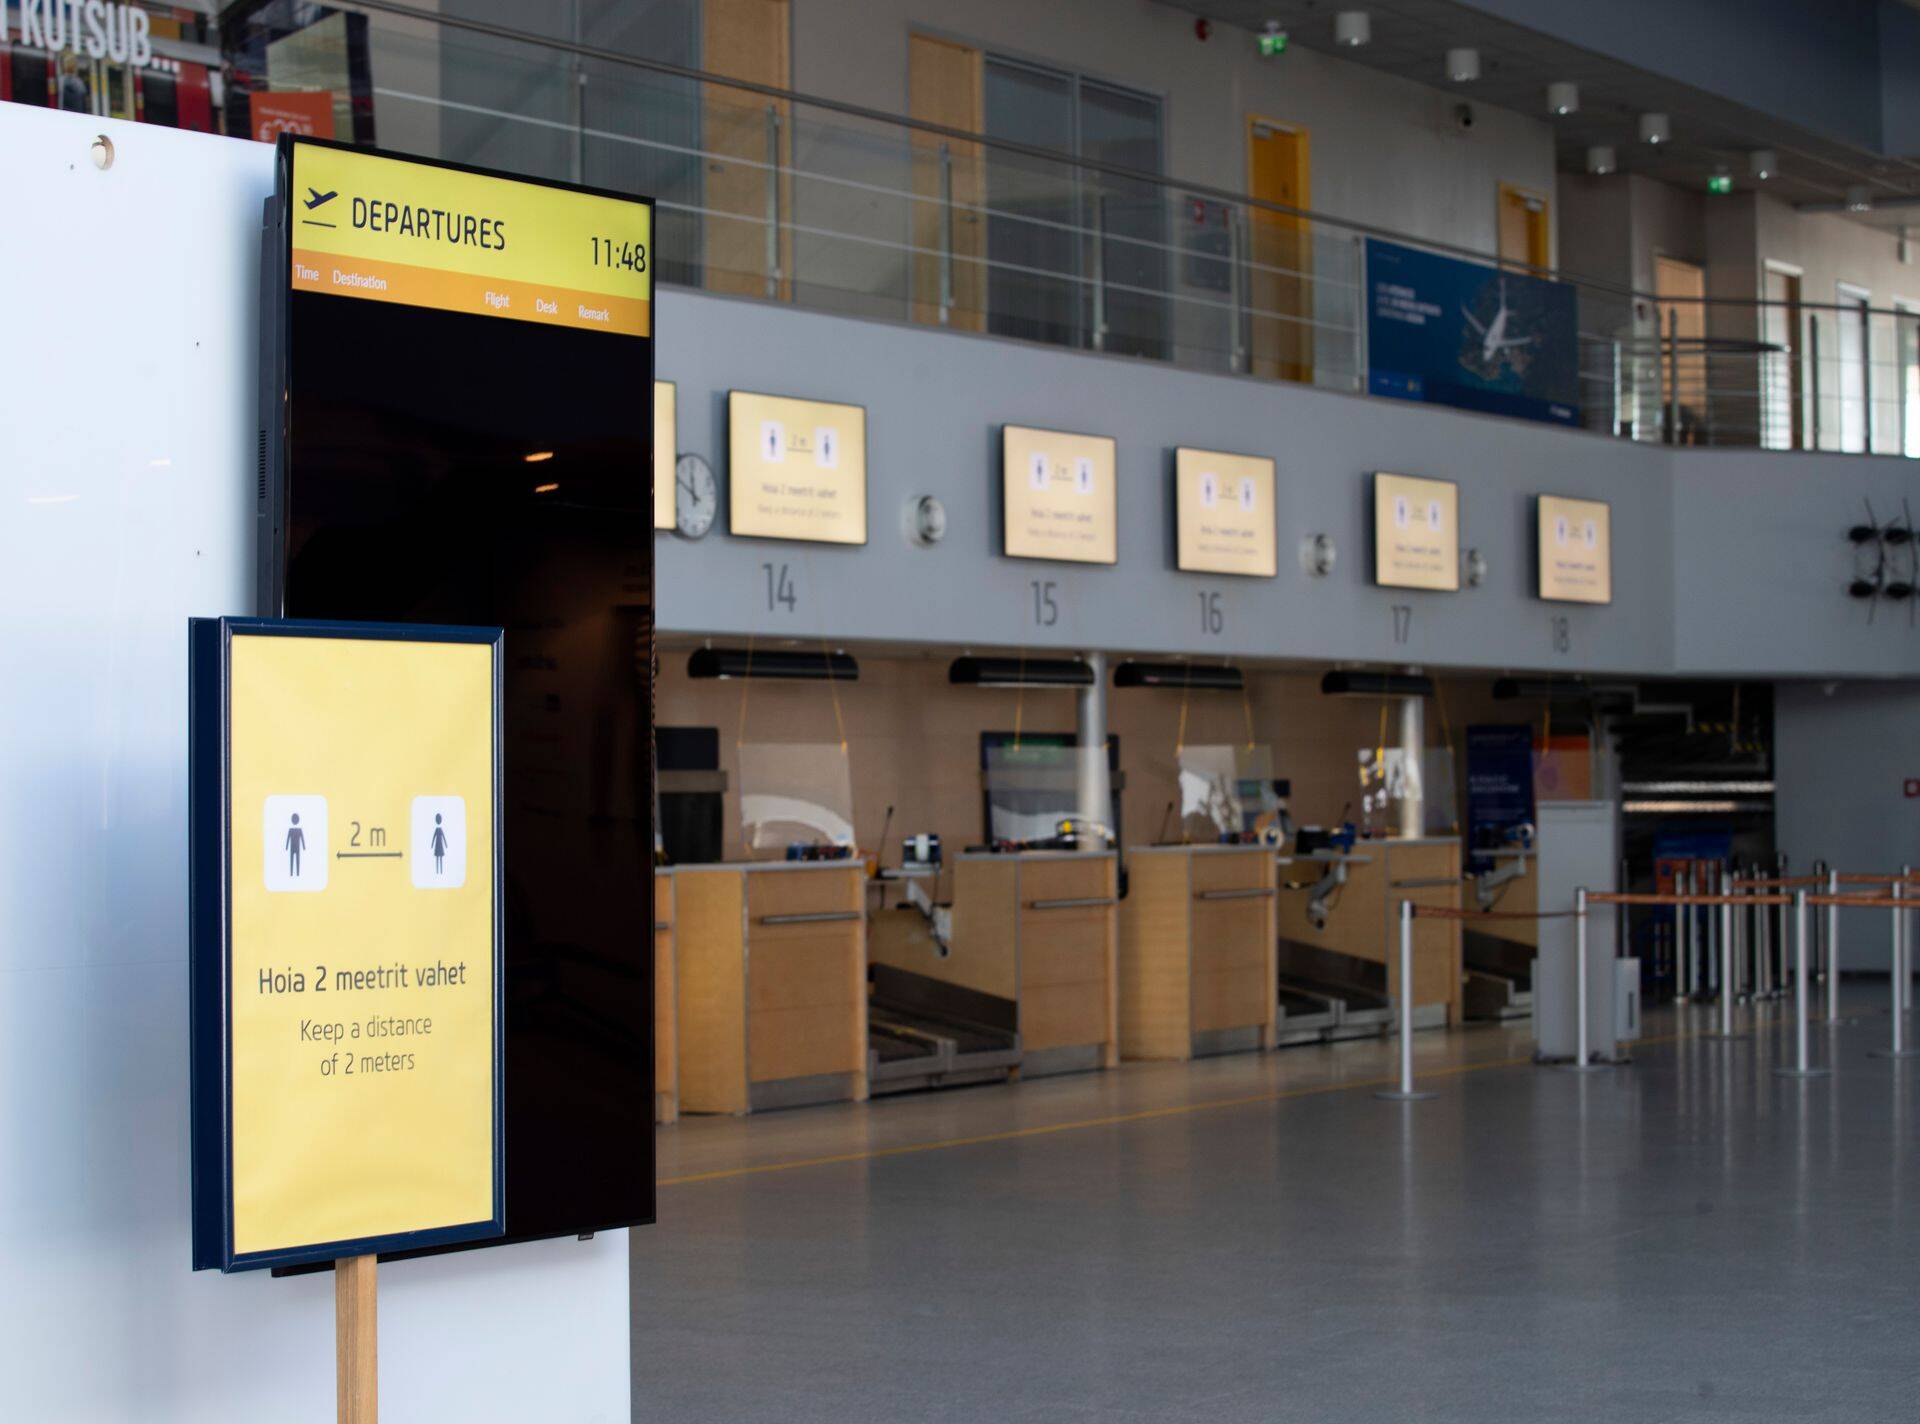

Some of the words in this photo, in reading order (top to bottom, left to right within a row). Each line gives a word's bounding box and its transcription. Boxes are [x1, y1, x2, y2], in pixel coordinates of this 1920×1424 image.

[352, 197, 505, 250] DEPARTURES
[591, 237, 646, 273] 11:48
[295, 264, 319, 281] Time
[333, 269, 387, 291] Destination
[485, 291, 511, 309] Flight
[535, 298, 559, 315] Desk
[578, 304, 610, 323] Remark
[762, 563, 797, 612] 14
[1031, 581, 1058, 627] 15
[1198, 590, 1223, 635] 16
[1392, 605, 1412, 645] 17
[350, 820, 361, 847] 2
[370, 827, 386, 847] m
[259, 966, 305, 994] Hoia
[315, 966, 327, 992] 2
[336, 962, 409, 992] meetrit
[415, 959, 466, 987] vahet
[301, 1018, 344, 1045] Keep
[350, 1021, 361, 1039] a
[366, 1014, 432, 1038] distance
[320, 1053, 339, 1077] of
[344, 1052, 355, 1075] 2
[360, 1051, 415, 1074] meters
